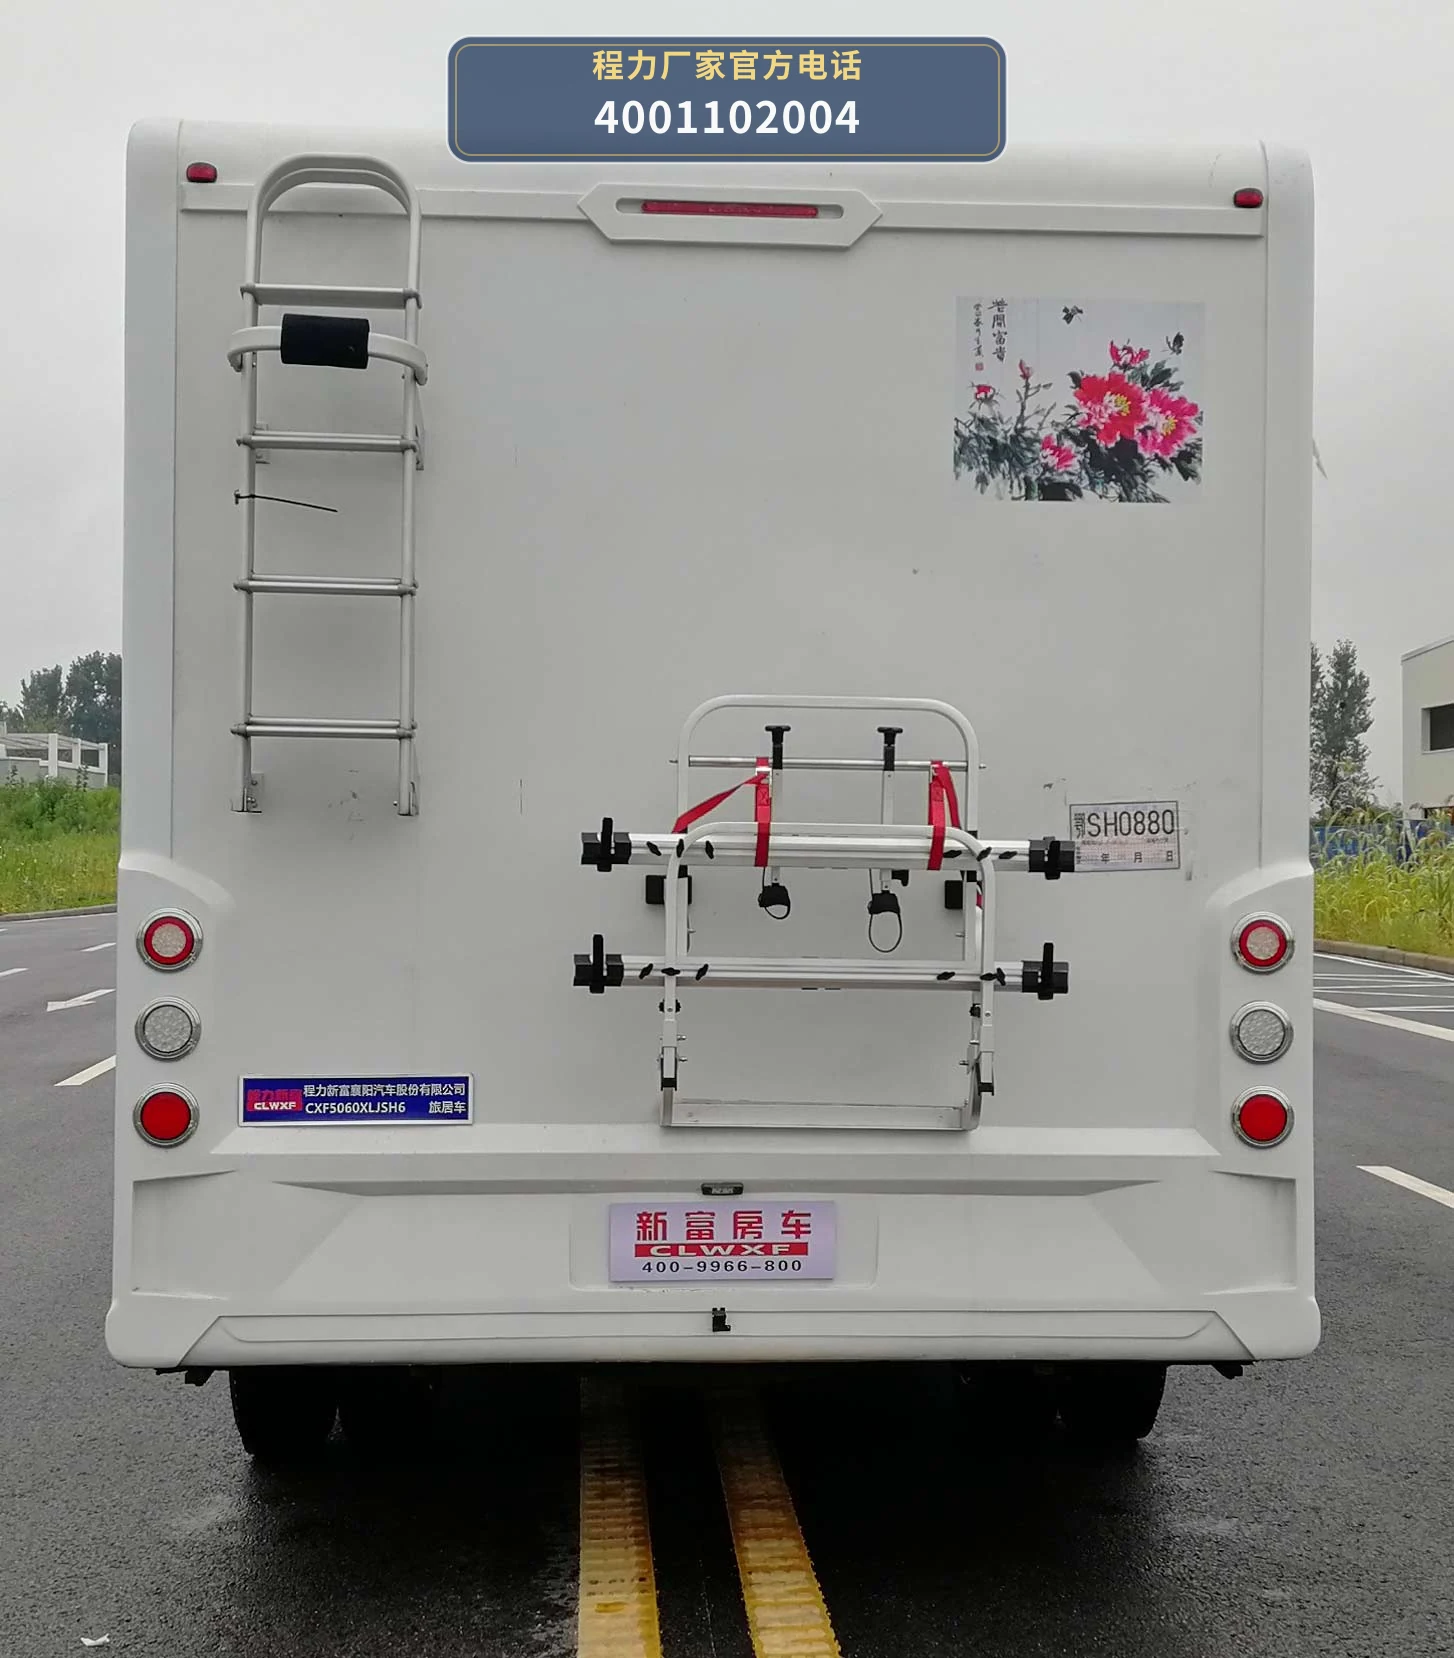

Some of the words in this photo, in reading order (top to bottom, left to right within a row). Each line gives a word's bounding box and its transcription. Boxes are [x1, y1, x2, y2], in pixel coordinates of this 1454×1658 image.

[253, 1101, 297, 1111] CLWXF
[305, 1101, 406, 1115] CXF5060XLJSH6
[429, 1100, 467, 1114] 旅居车
[636, 1210, 812, 1241] 新富房车
[649, 1244, 790, 1257] CLWXF
[642, 1259, 802, 1273] 400-9966-800
